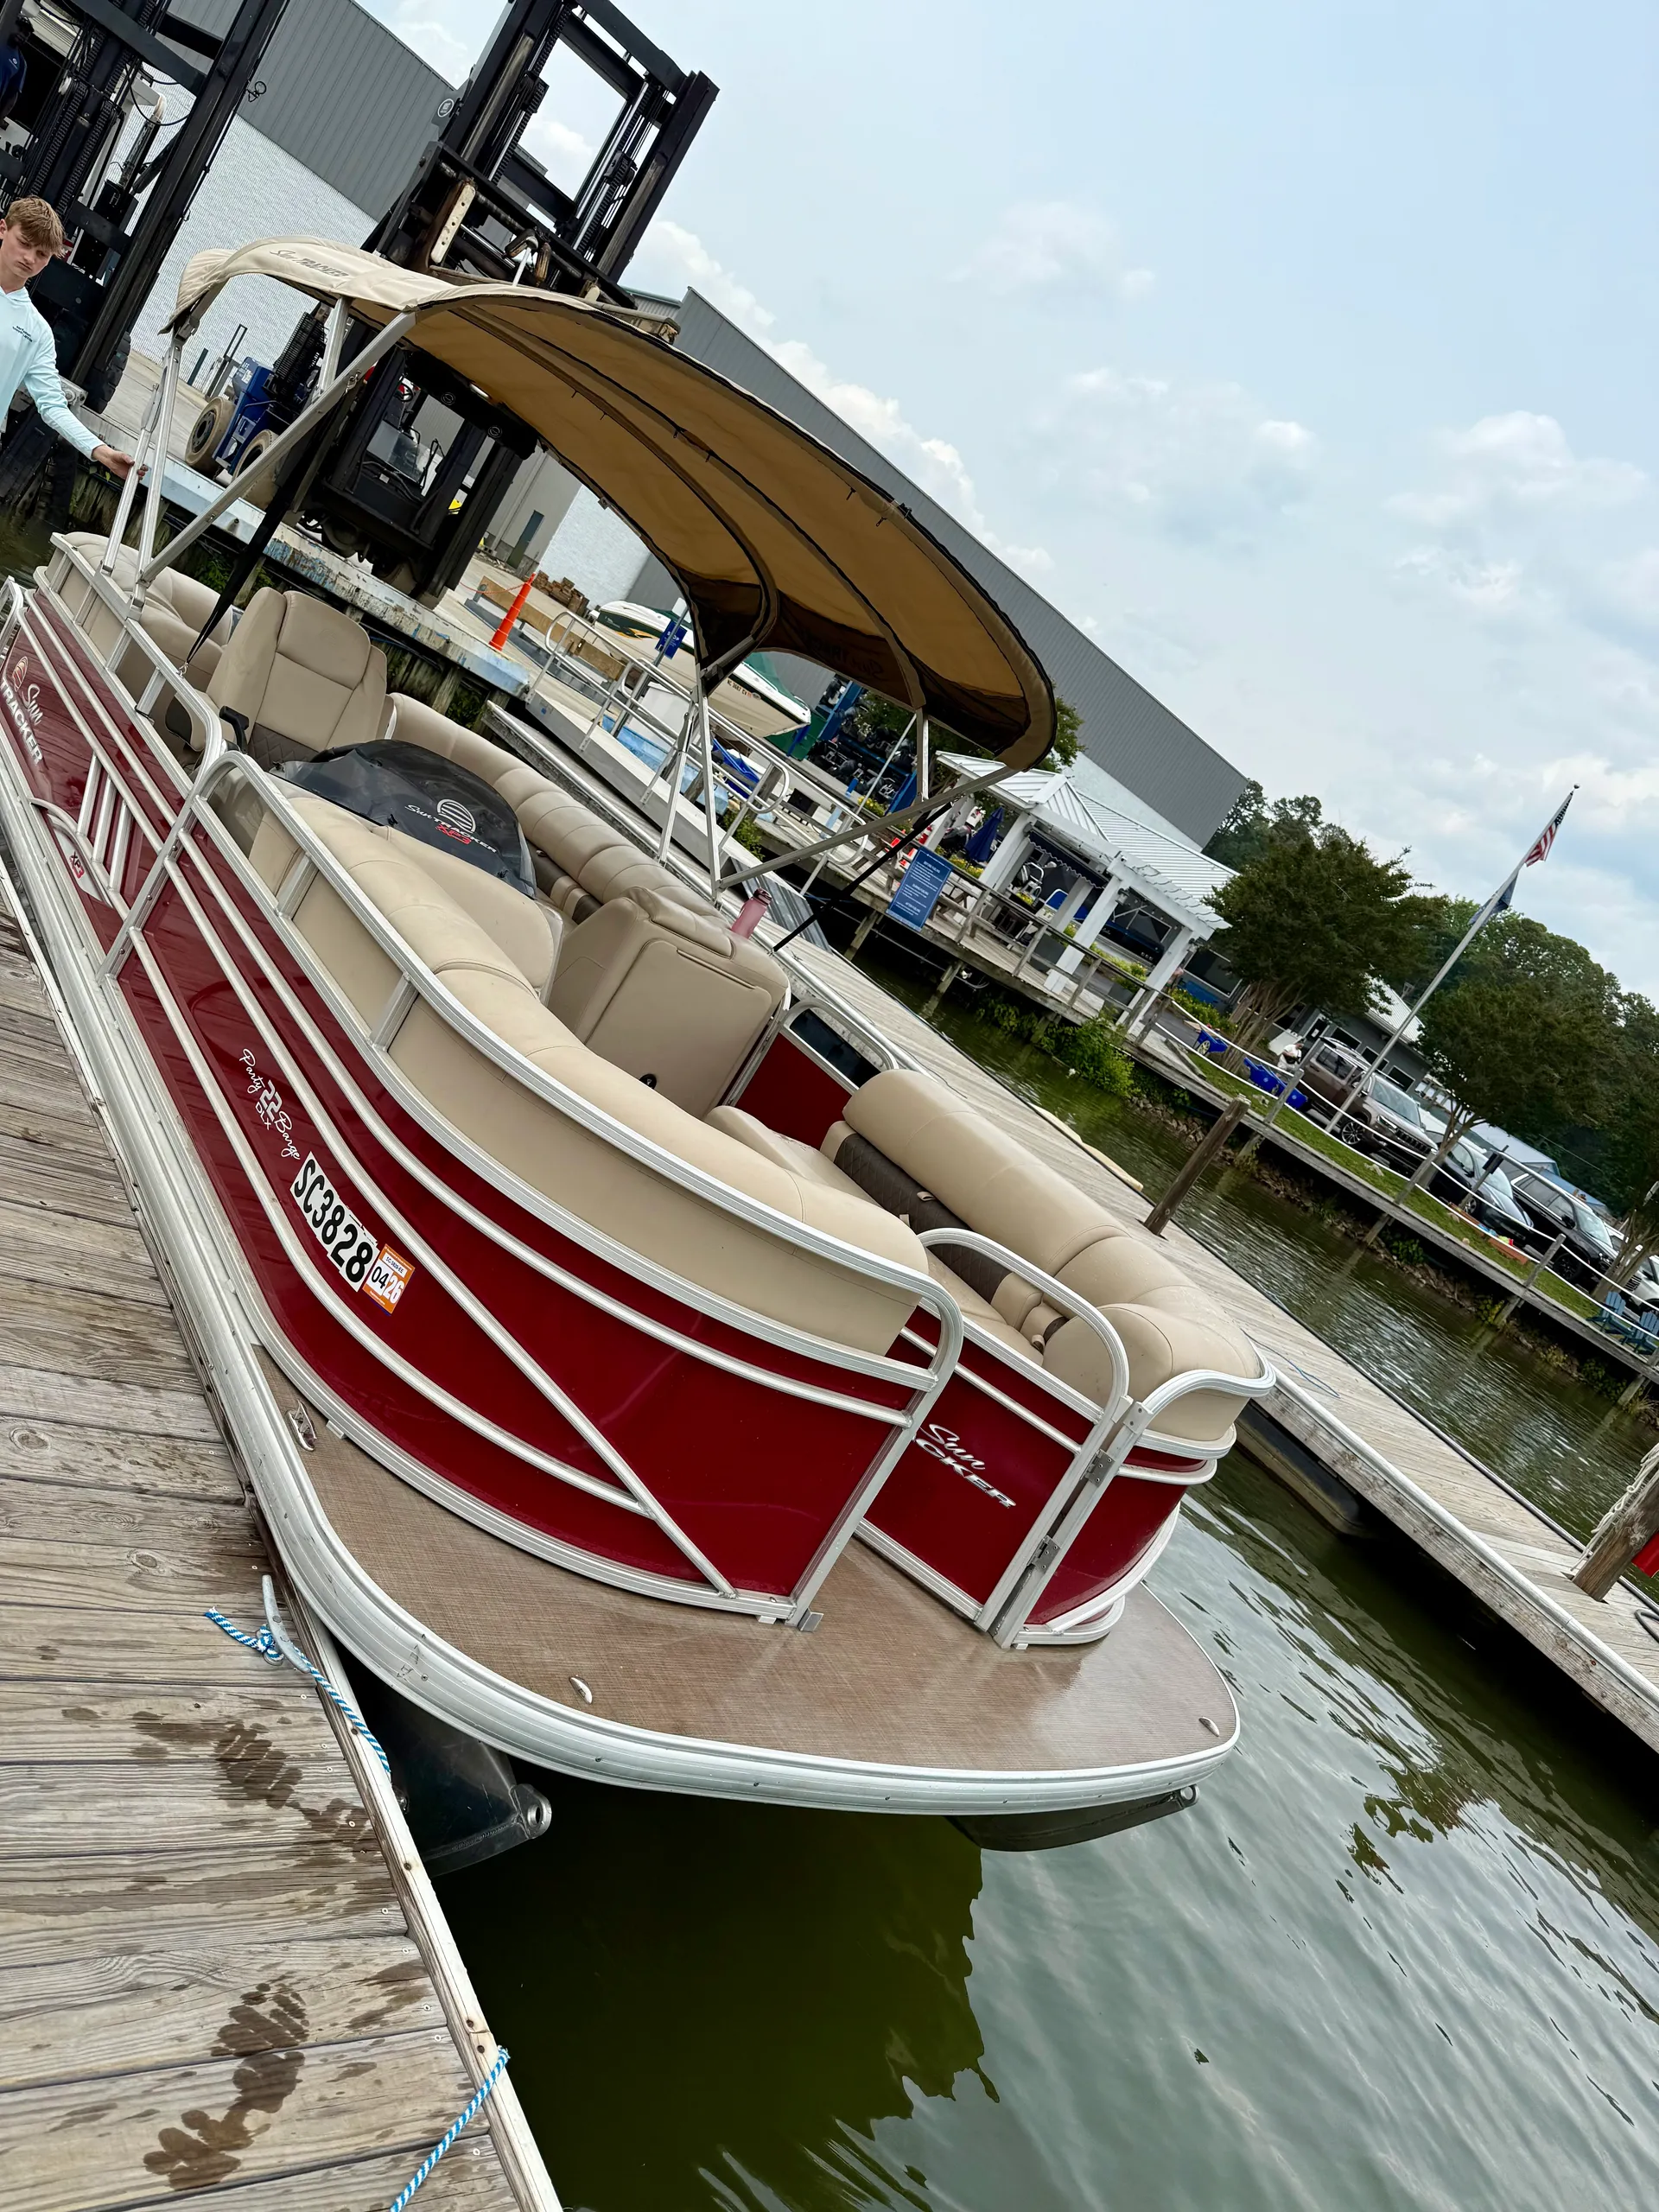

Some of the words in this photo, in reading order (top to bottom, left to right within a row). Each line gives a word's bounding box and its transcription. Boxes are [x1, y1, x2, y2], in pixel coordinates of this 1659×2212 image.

[1, 677, 43, 765] TRACKER
[22, 683, 43, 726] Sun
[404, 804, 433, 819] Sun
[433, 817, 497, 853] TRACKER
[70, 851, 85, 879] XP3
[239, 1048, 265, 1094] Party
[259, 1079, 283, 1122] 22
[274, 1110, 301, 1160] Barge
[255, 1102, 271, 1130] DLX
[294, 1159, 373, 1283] SC3828
[372, 1266, 390, 1289] 04
[383, 1274, 405, 1304] 26
[919, 1423, 985, 1470] Sun
[912, 1435, 1016, 1509] CKER
